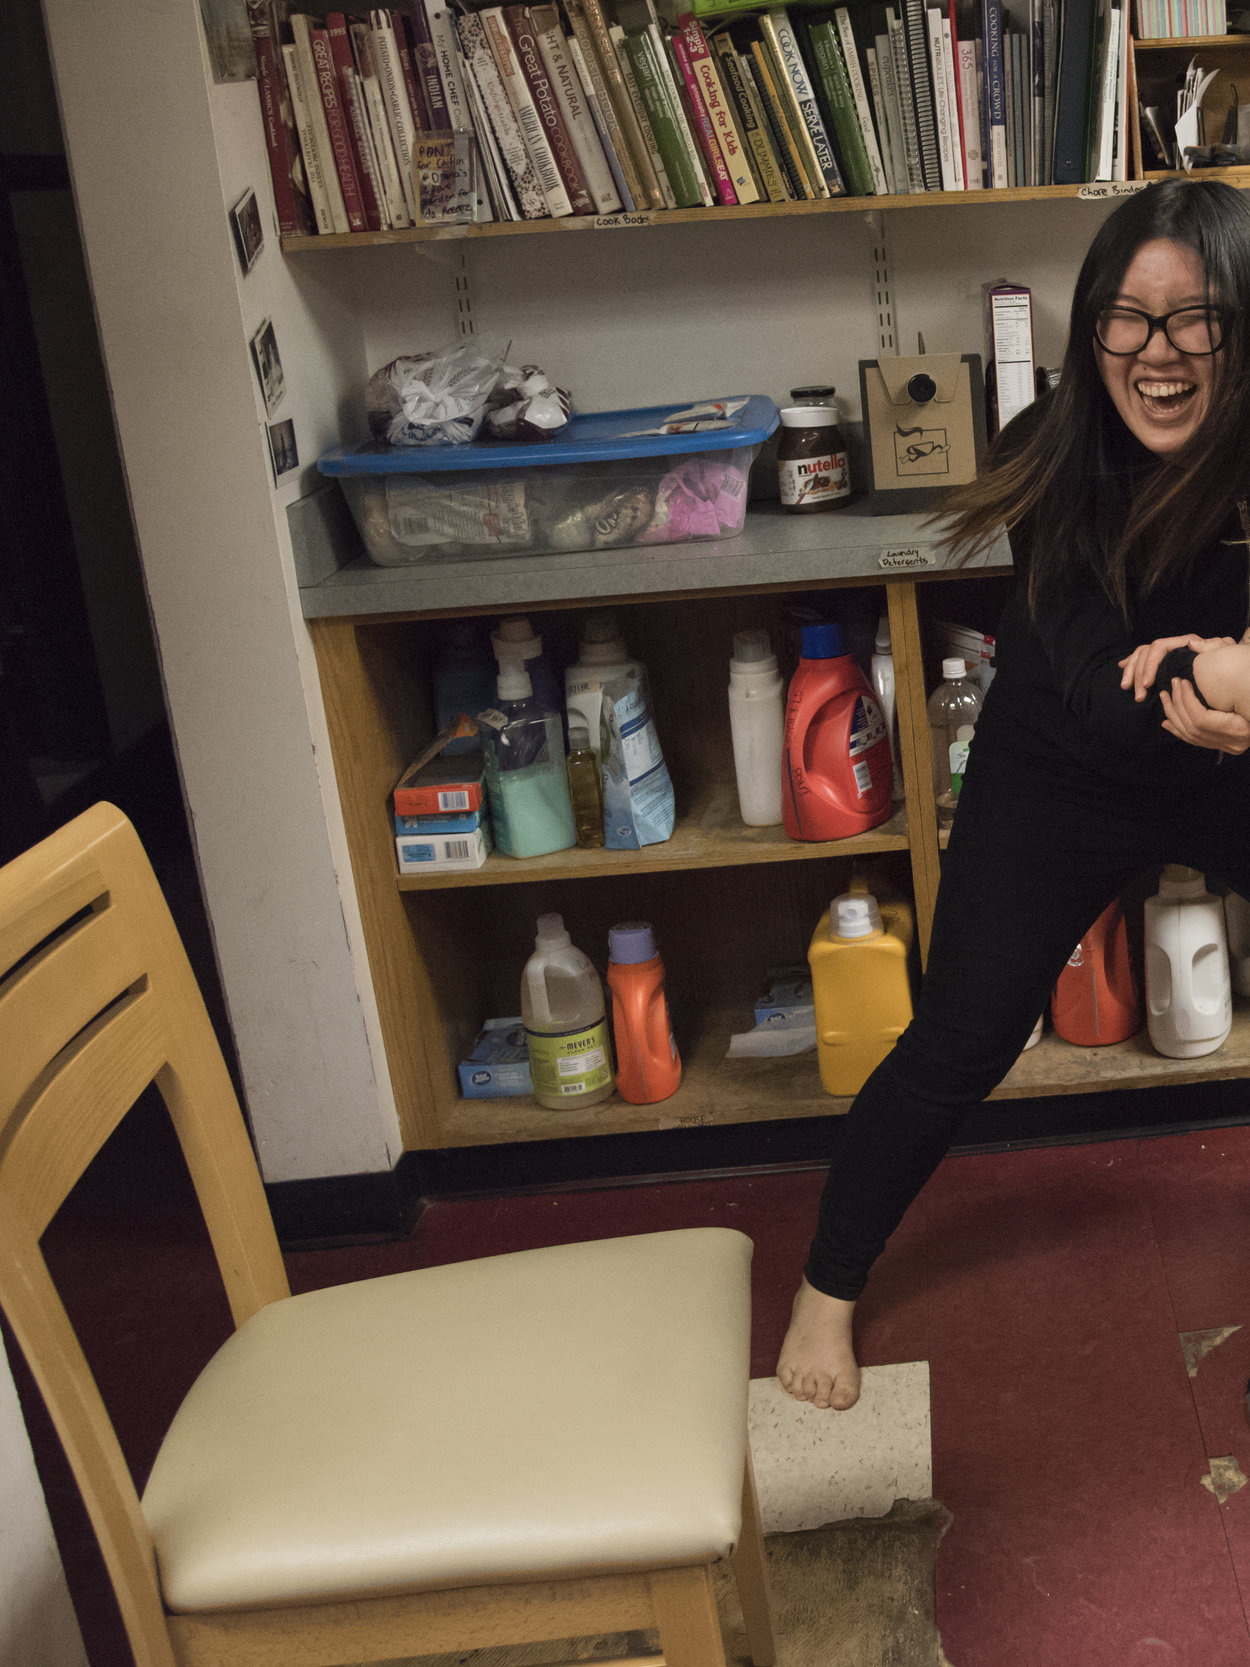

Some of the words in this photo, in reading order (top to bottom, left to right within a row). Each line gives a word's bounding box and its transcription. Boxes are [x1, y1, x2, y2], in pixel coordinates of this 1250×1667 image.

[435, 34, 445, 47] My
[683, 27, 699, 53] 1-2-3
[689, 20, 706, 54] Simple
[989, 7, 1001, 57] COOKING
[313, 39, 330, 70] GREAT
[441, 50, 454, 78] HOME
[552, 53, 563, 64] &
[638, 51, 652, 80] vegan
[961, 49, 974, 70] 365
[319, 71, 338, 109] RECIPES
[425, 74, 444, 109] INDIAN
[447, 81, 460, 106] CHEF
[556, 64, 583, 121] NATURAL
[576, 28, 601, 86] COOKIE
[597, 89, 620, 131] BOOK
[725, 56, 745, 92] Seafood
[738, 91, 756, 129] Cooking
[869, 60, 880, 97] SPICES
[519, 34, 543, 79] Great
[533, 79, 557, 127] Potato
[551, 127, 581, 192] COOKBOOK
[690, 83, 707, 118] girlosophy
[700, 64, 721, 110] Cooking
[716, 110, 728, 129] for
[722, 130, 739, 157] Kids
[778, 28, 796, 62] COOK
[788, 63, 810, 96] NOW
[801, 101, 823, 139] SERVE
[812, 132, 833, 171] LATER
[992, 81, 1002, 120] CROWD
[328, 108, 340, 128] FOR
[631, 89, 647, 123] EVERYDAY
[643, 123, 658, 155] COOKING
[939, 100, 948, 136] Changing
[332, 128, 347, 159] GOOD
[395, 121, 411, 166] COLLECTION
[340, 157, 356, 197] HEALTH
[533, 146, 561, 193] COOKBOOK
[753, 138, 778, 189] DUMMIES
[1081, 187, 1108, 197] Chore
[596, 216, 620, 226] Cook
[798, 454, 846, 474] nutella
[882, 555, 928, 566] Detergents
[887, 549, 919, 559] Laundry
[567, 1036, 596, 1050] MEYER'S
